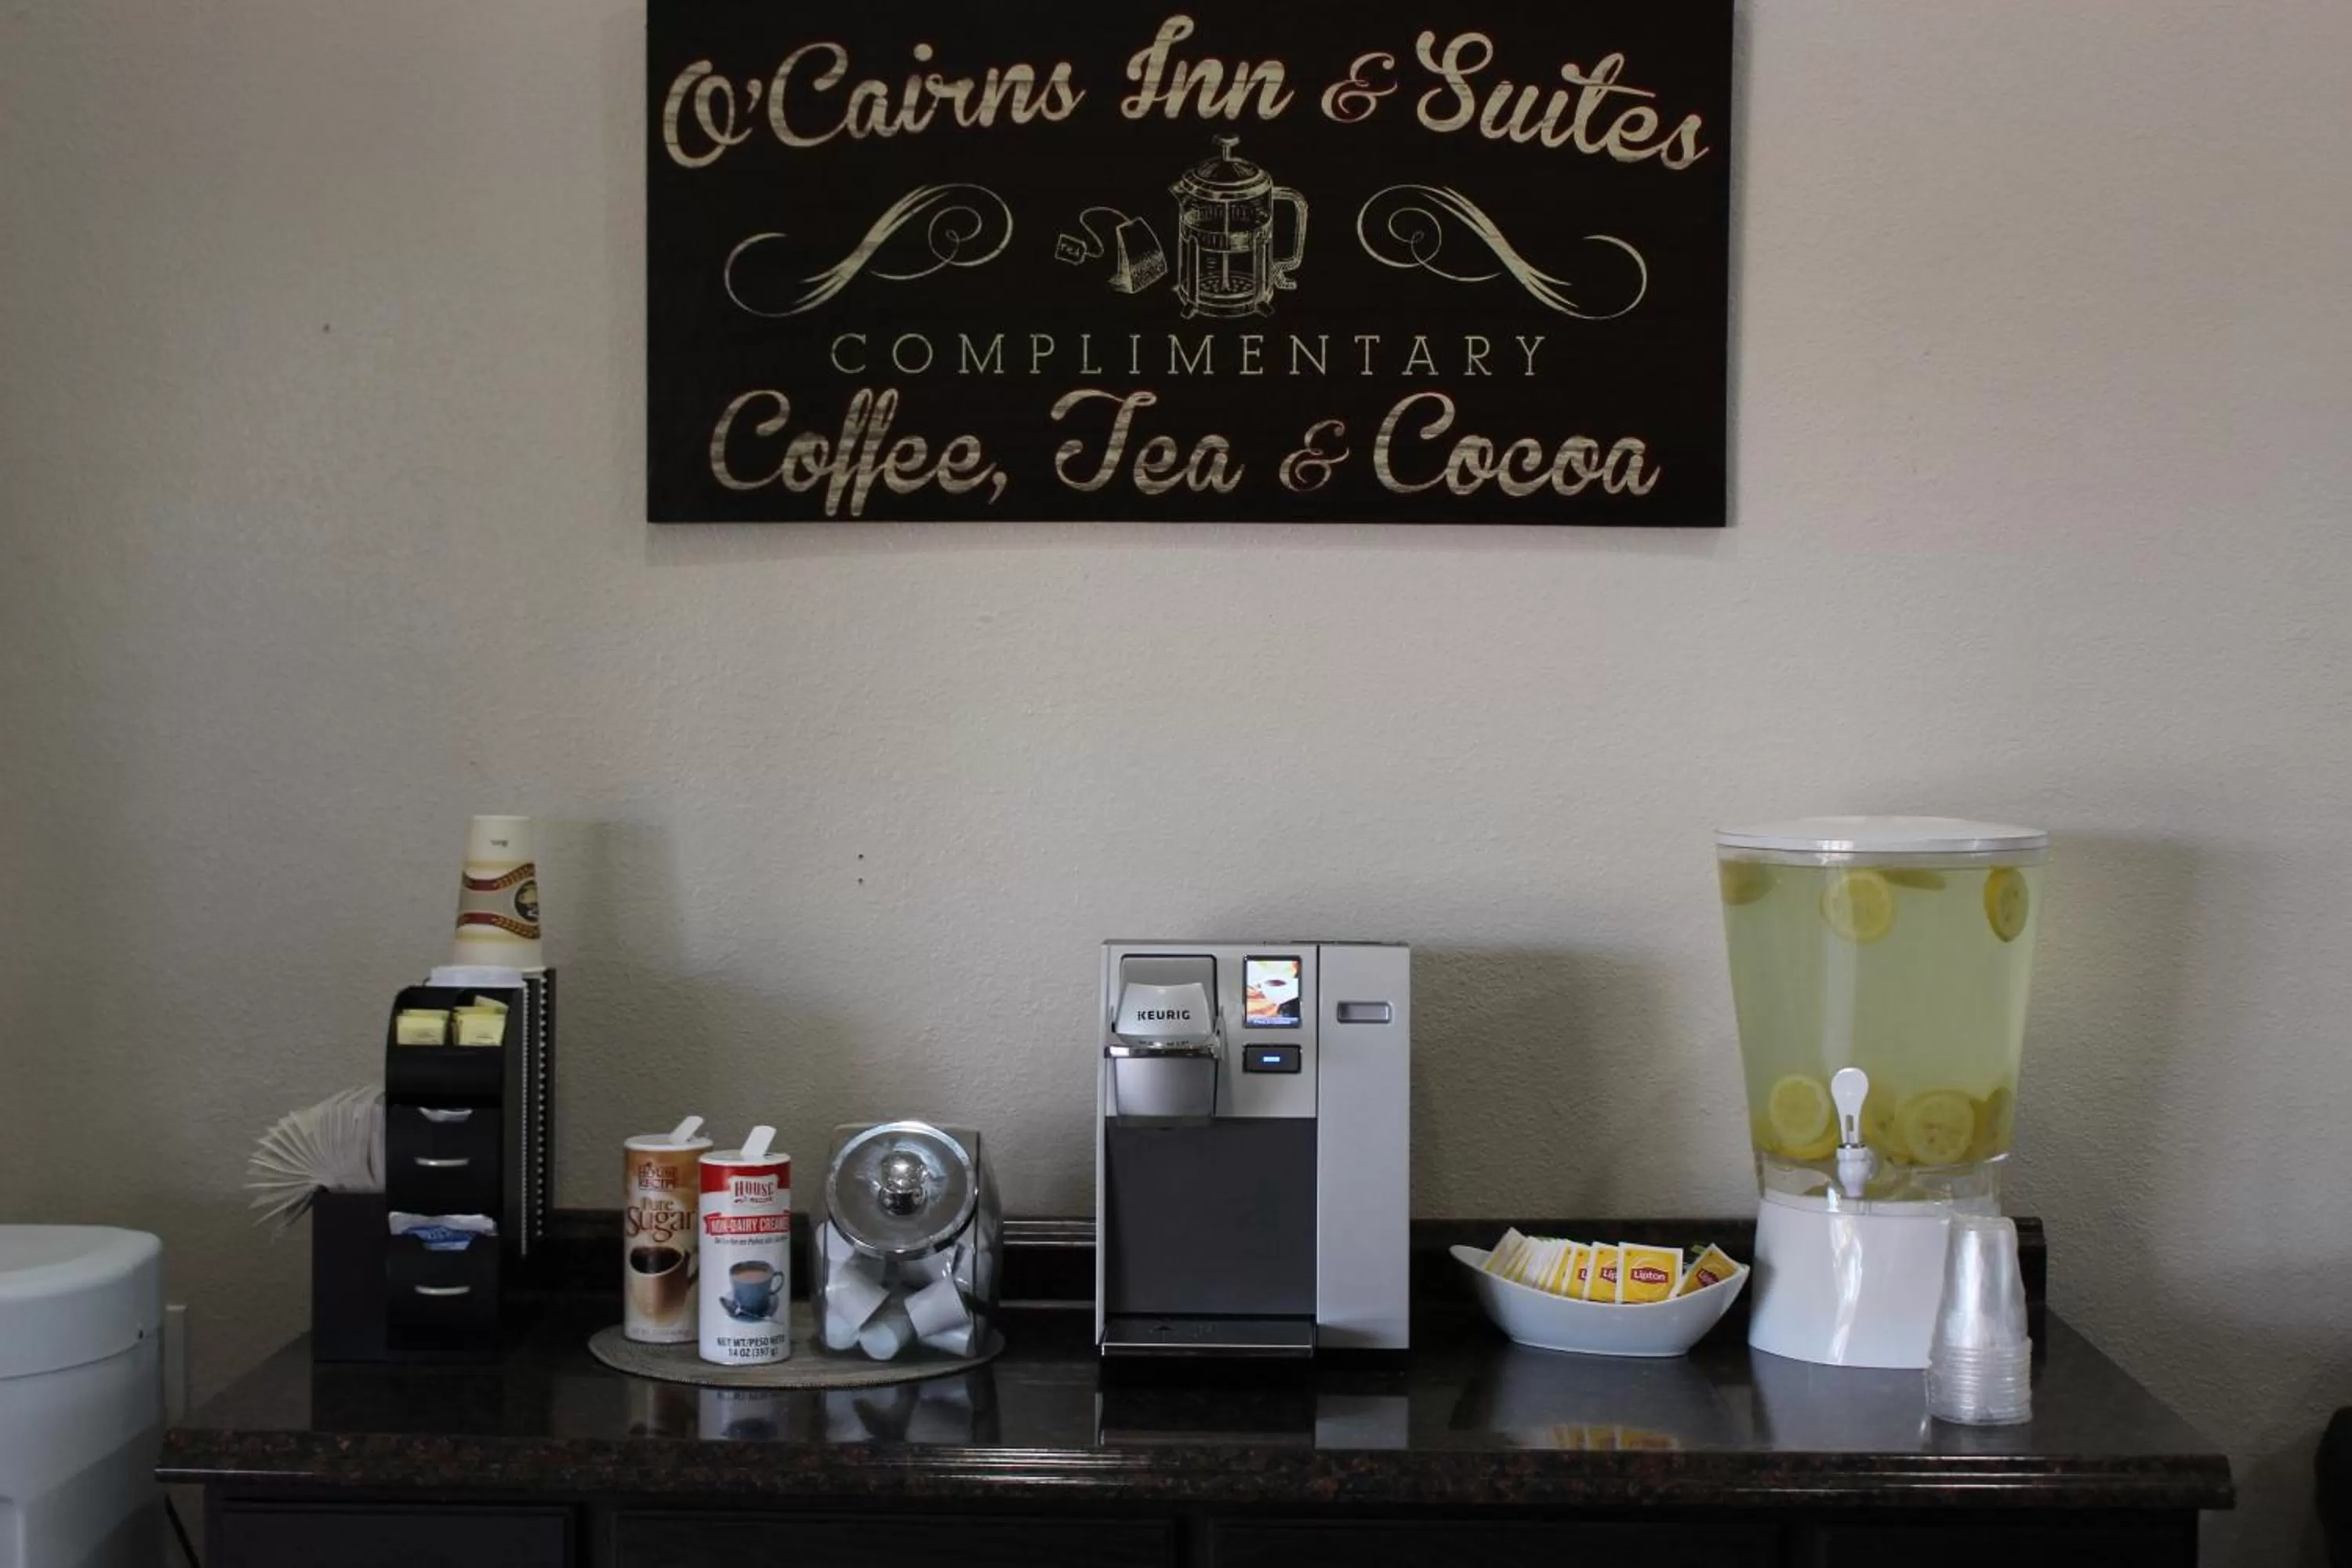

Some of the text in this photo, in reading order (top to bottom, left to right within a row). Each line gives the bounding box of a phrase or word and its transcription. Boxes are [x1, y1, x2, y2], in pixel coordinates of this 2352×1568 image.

[663, 15, 1709, 169] O'Cairns Inn & Suites
[831, 334, 1544, 376] COMPLIMENTARY
[710, 388, 1661, 517] Coffee, Tea & Cocoa
[1138, 1010, 1191, 1021] KEURIG
[626, 1205, 696, 1243] Sugar
[1633, 1270, 1667, 1282] Lipton
[739, 1348, 751, 1357] OZ
